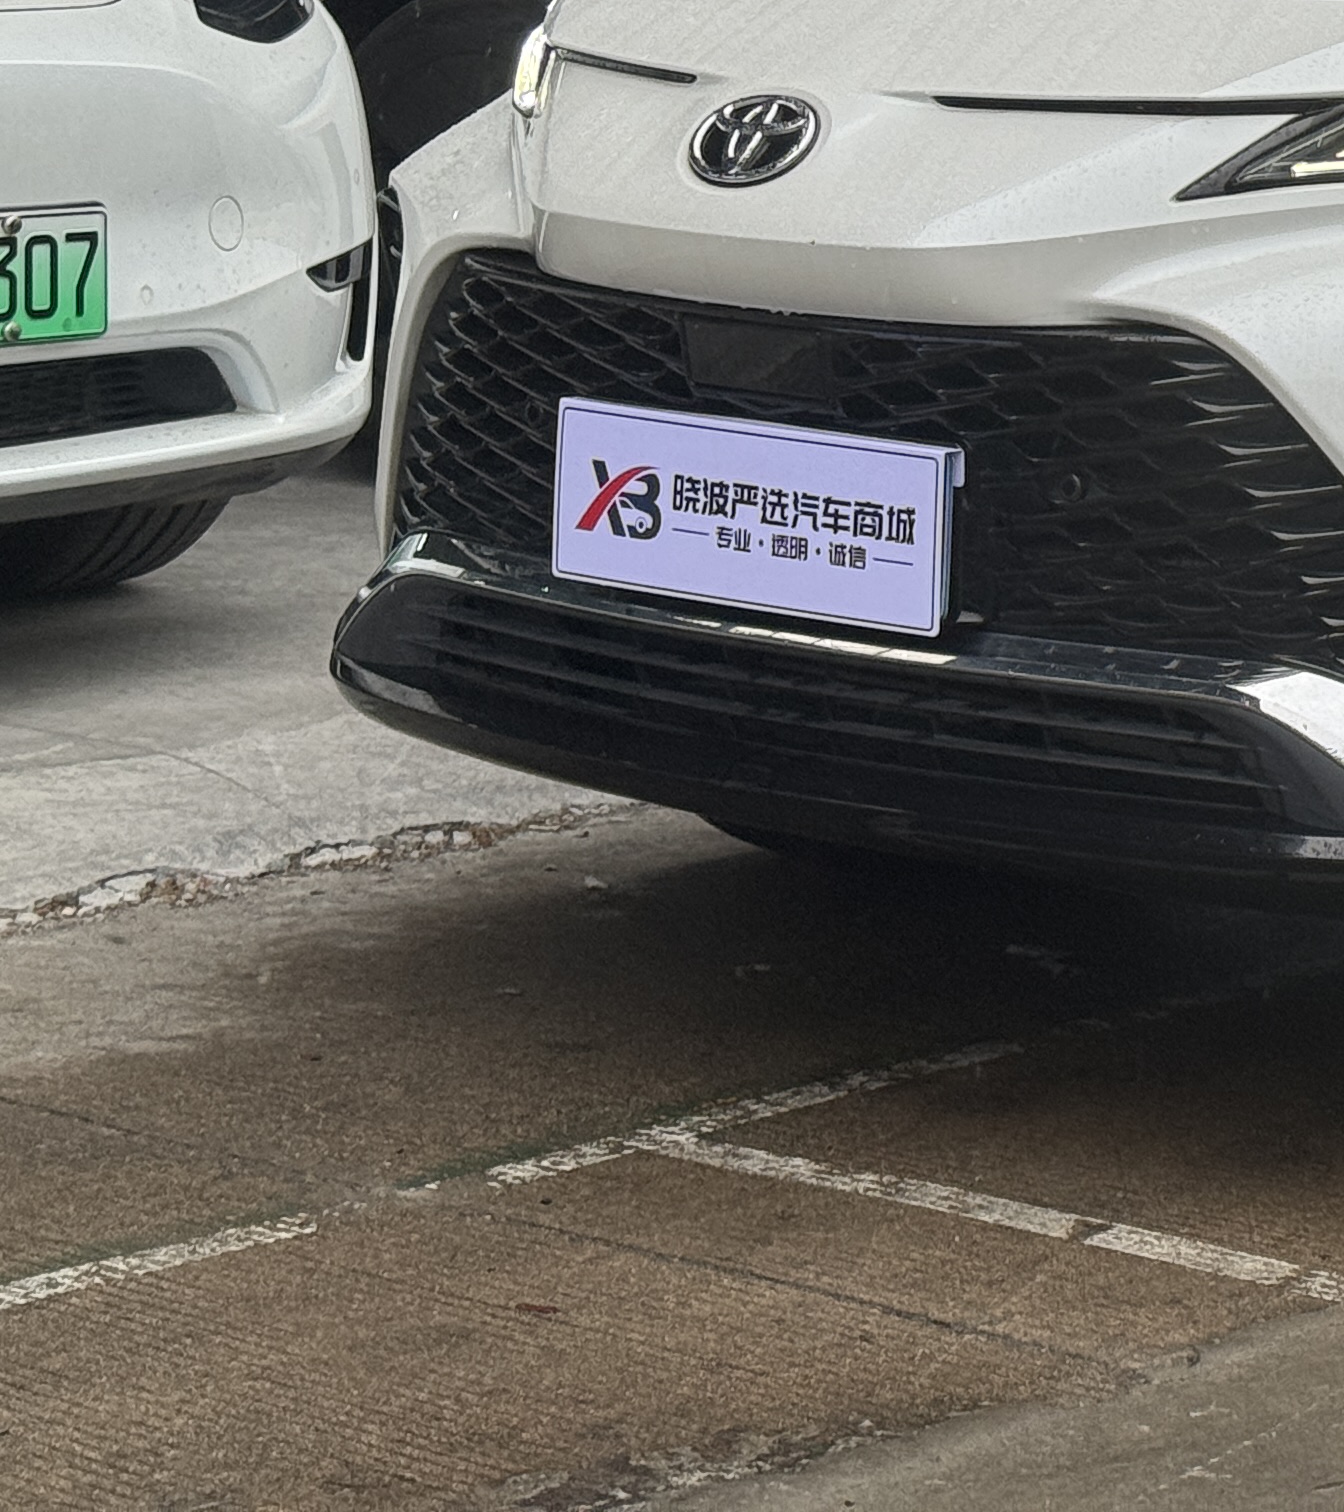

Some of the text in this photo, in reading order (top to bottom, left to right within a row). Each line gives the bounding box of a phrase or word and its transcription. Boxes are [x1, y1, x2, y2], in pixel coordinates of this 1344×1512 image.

[672, 472, 917, 546] 晓波严选汽车商城
